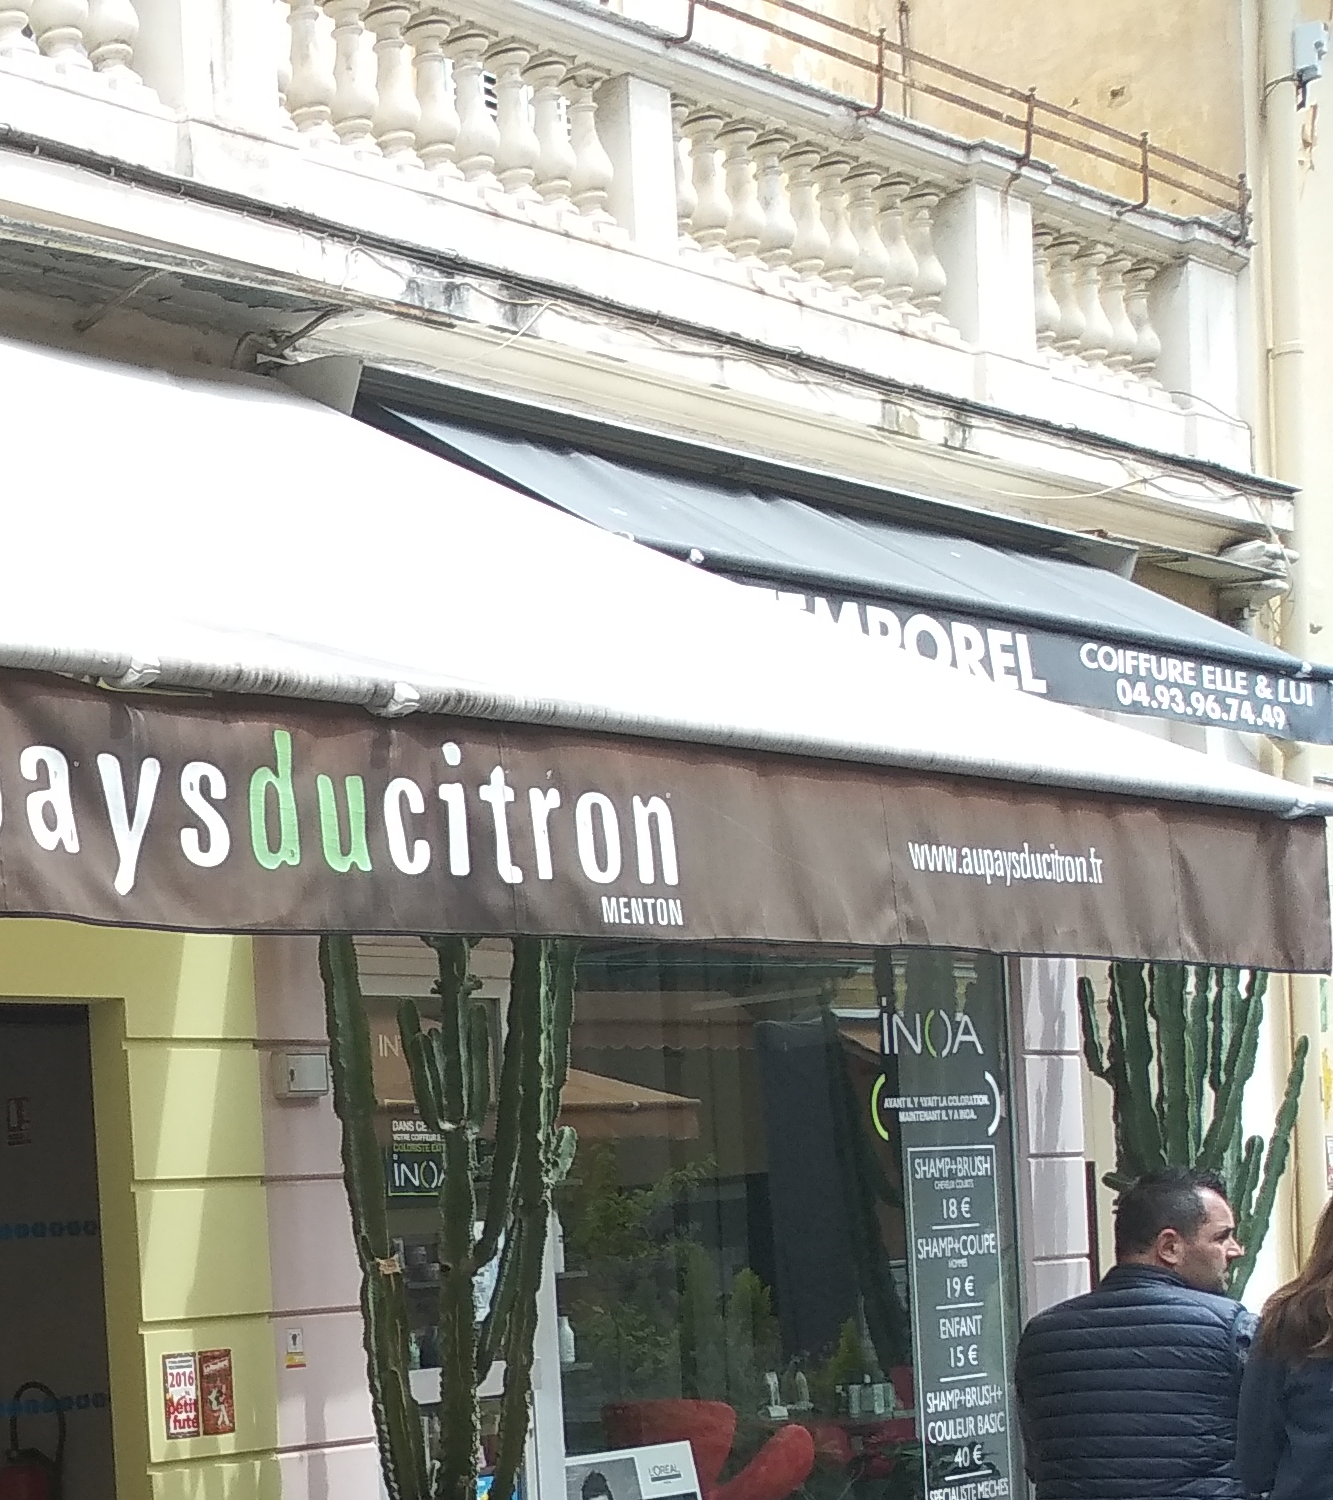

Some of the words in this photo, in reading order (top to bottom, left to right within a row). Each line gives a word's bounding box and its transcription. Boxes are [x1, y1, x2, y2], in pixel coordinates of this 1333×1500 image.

[1079, 642, 1197, 687] COIFFURE
[1201, 664, 1249, 696] ELLE
[1254, 674, 1274, 700] &
[1277, 678, 1314, 707] LUI
[1115, 678, 1287, 731] 04.93.96.74.49
[907, 841, 1104, 887] www.aupaysducitron.fr
[600, 895, 685, 927] MENTON
[392, 1120, 415, 1132] DANS
[914, 1155, 992, 1180] SHAMP+BRUSH
[917, 1233, 997, 1259] SHAMP+COUPE
[939, 1315, 983, 1340] ENFANT
[168, 1370, 194, 1388] 2016
[926, 1384, 1004, 1414] SHAMP+BRUSH+
[927, 1416, 976, 1444] COULEUR
[977, 1411, 1006, 1436] BASIC
[954, 1446, 971, 1468] 40
[977, 1477, 1009, 1500] MECHES
